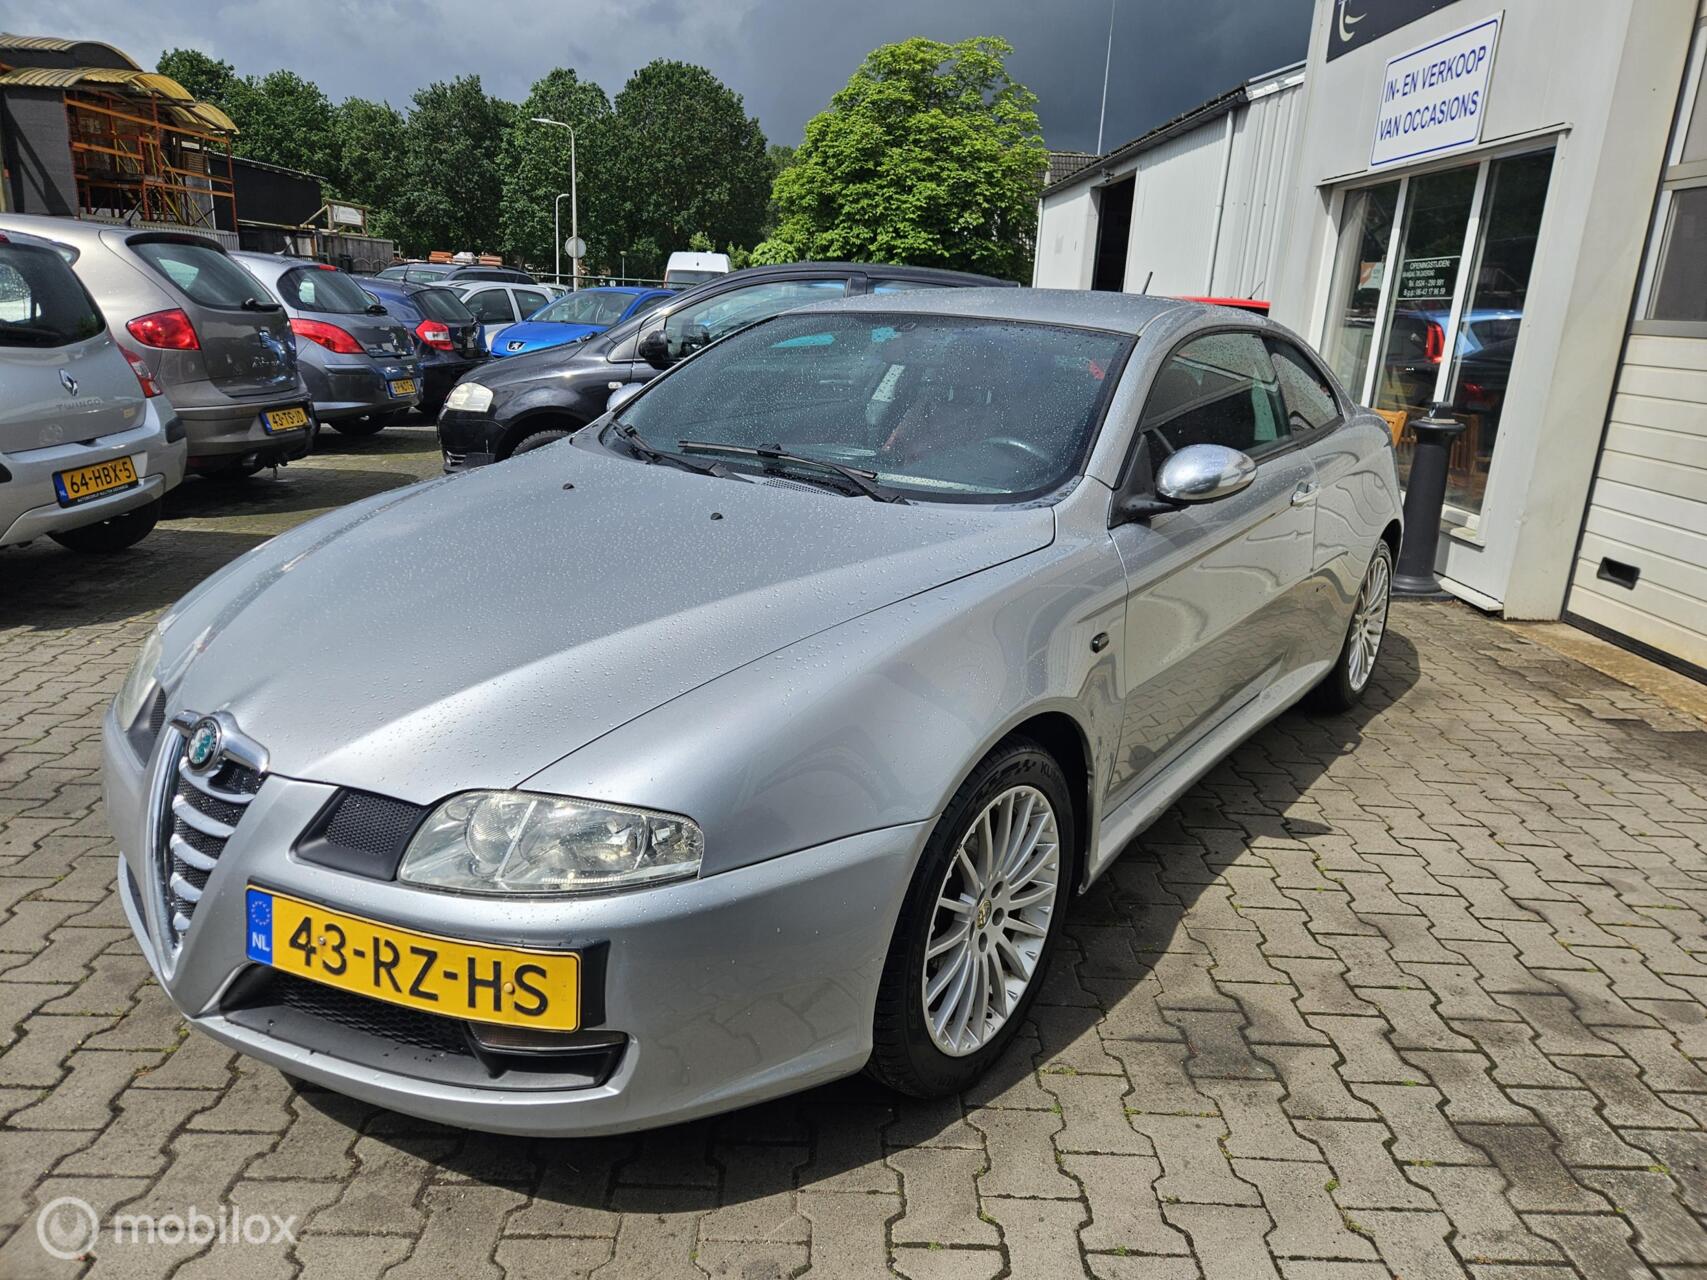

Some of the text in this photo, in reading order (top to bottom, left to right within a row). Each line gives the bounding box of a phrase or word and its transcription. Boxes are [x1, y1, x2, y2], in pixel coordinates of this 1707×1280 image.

[1385, 45, 1487, 103] IN- EN VERKOOP
[1379, 90, 1479, 141] VAN OCCASIONS
[70, 461, 132, 494] 64-HBX-5
[252, 931, 271, 953] NL
[288, 915, 549, 1017] 43-RZ-HS
